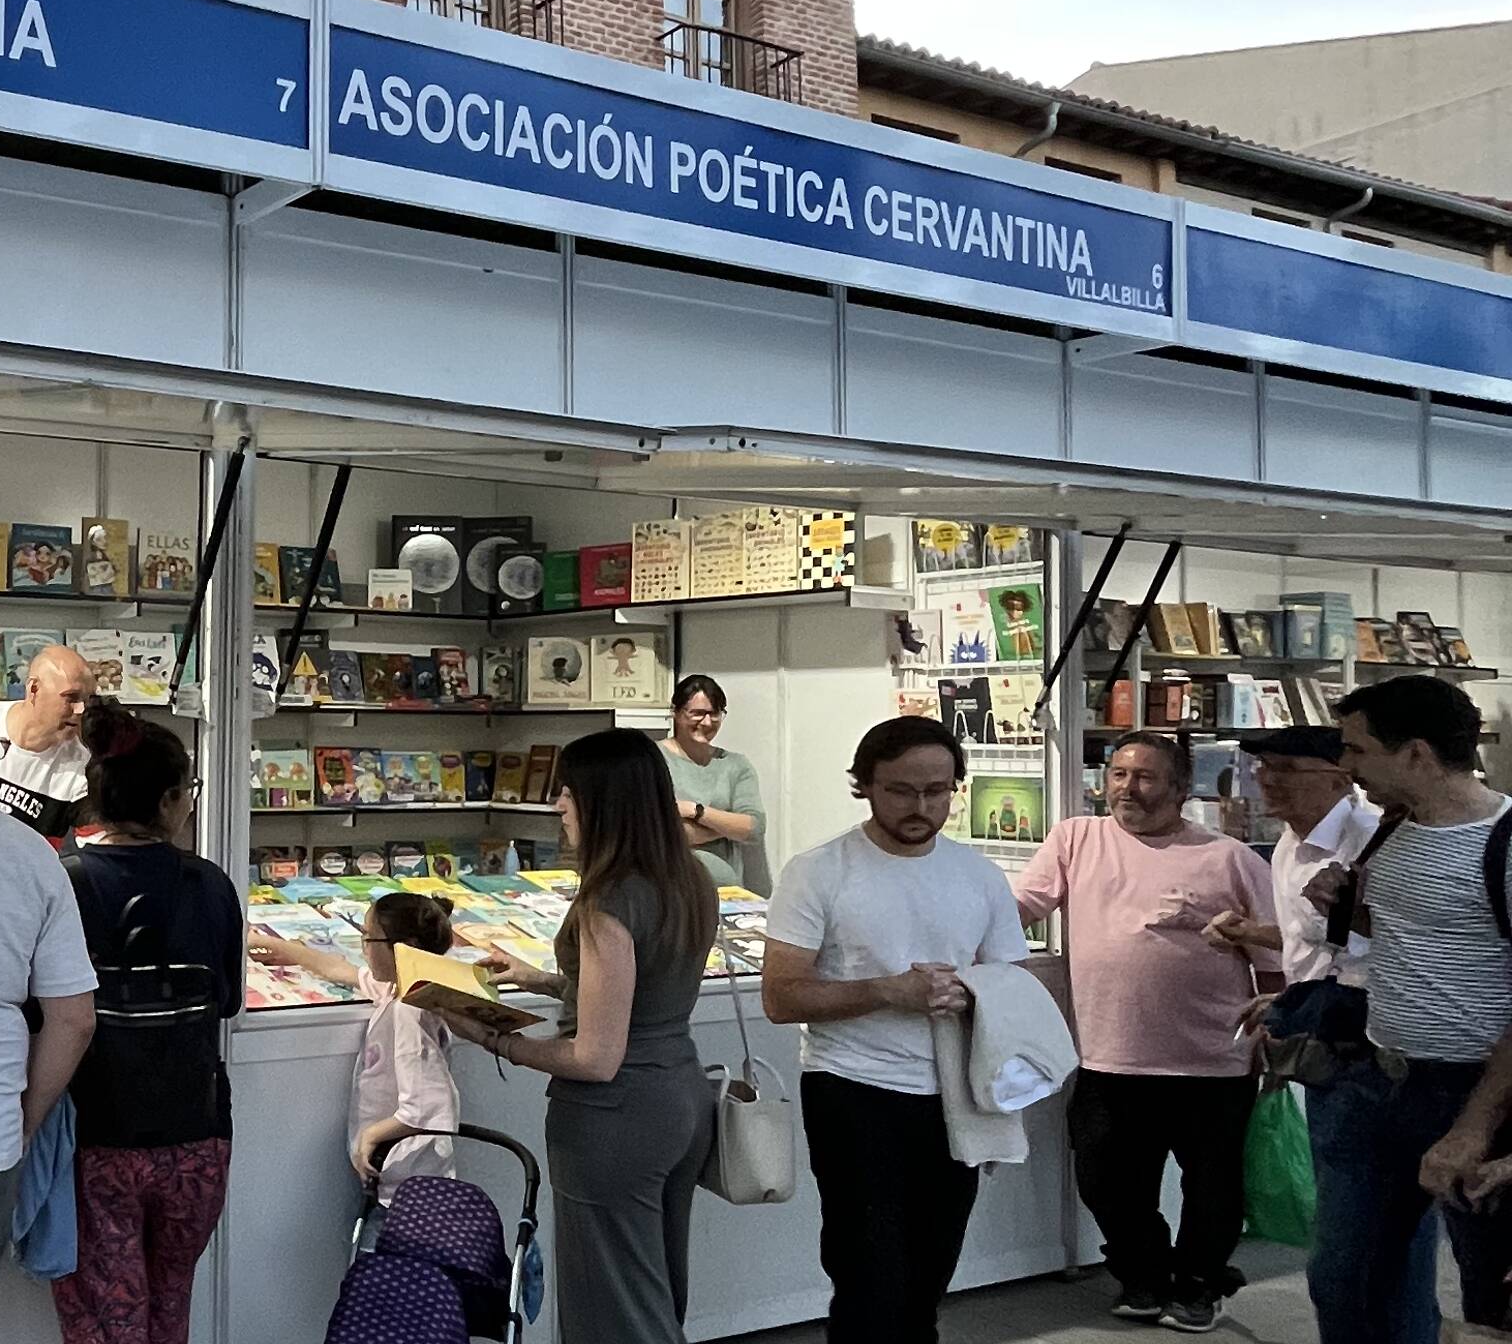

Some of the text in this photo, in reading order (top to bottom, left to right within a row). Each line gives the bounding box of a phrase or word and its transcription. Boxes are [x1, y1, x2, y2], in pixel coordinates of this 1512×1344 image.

[275, 78, 293, 114] 7
[338, 68, 1094, 277] ASOCIACIÓN POÉTICA CERVANTINA
[1151, 263, 1164, 288] 6
[1065, 276, 1167, 312] VILLALBILLA
[147, 534, 190, 552] ELLAS
